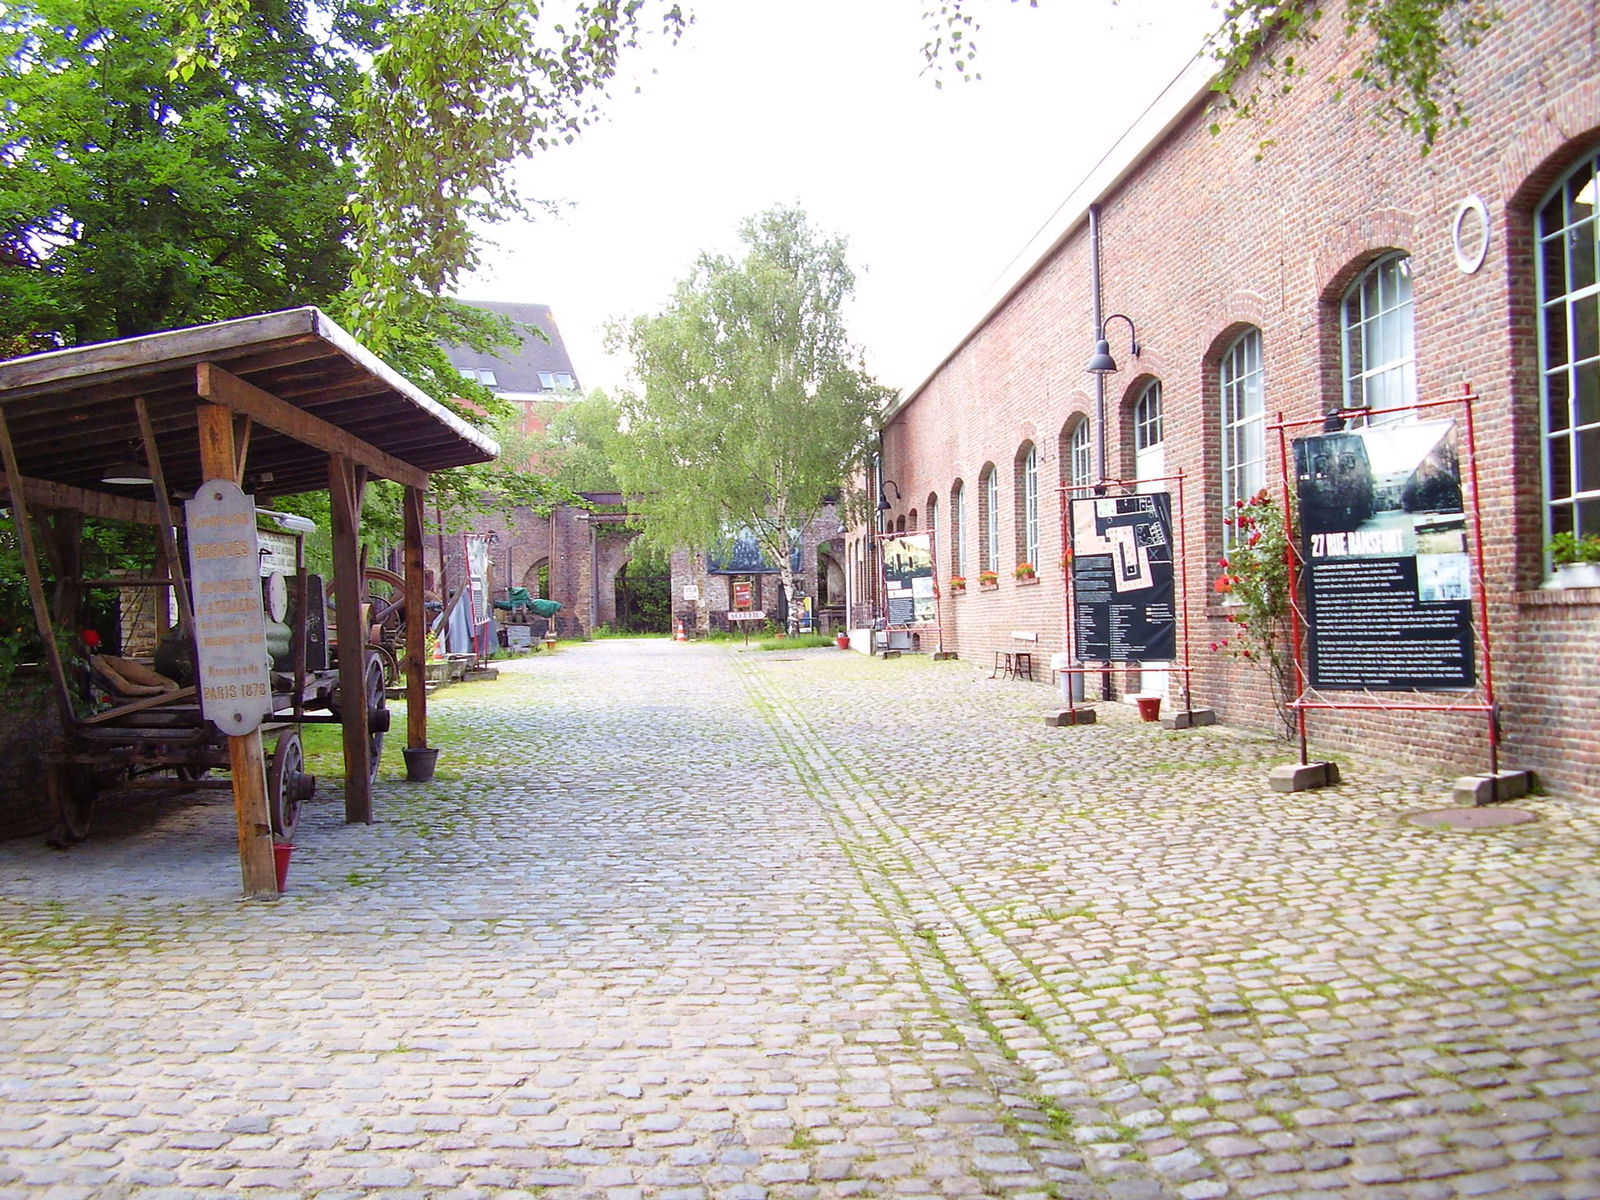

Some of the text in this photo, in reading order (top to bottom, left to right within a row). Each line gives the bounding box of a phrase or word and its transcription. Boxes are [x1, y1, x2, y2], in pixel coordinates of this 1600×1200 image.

[1310, 528, 1403, 557] 27 RUE RANSFORT
[204, 682, 267, 700] PARIS 1878
